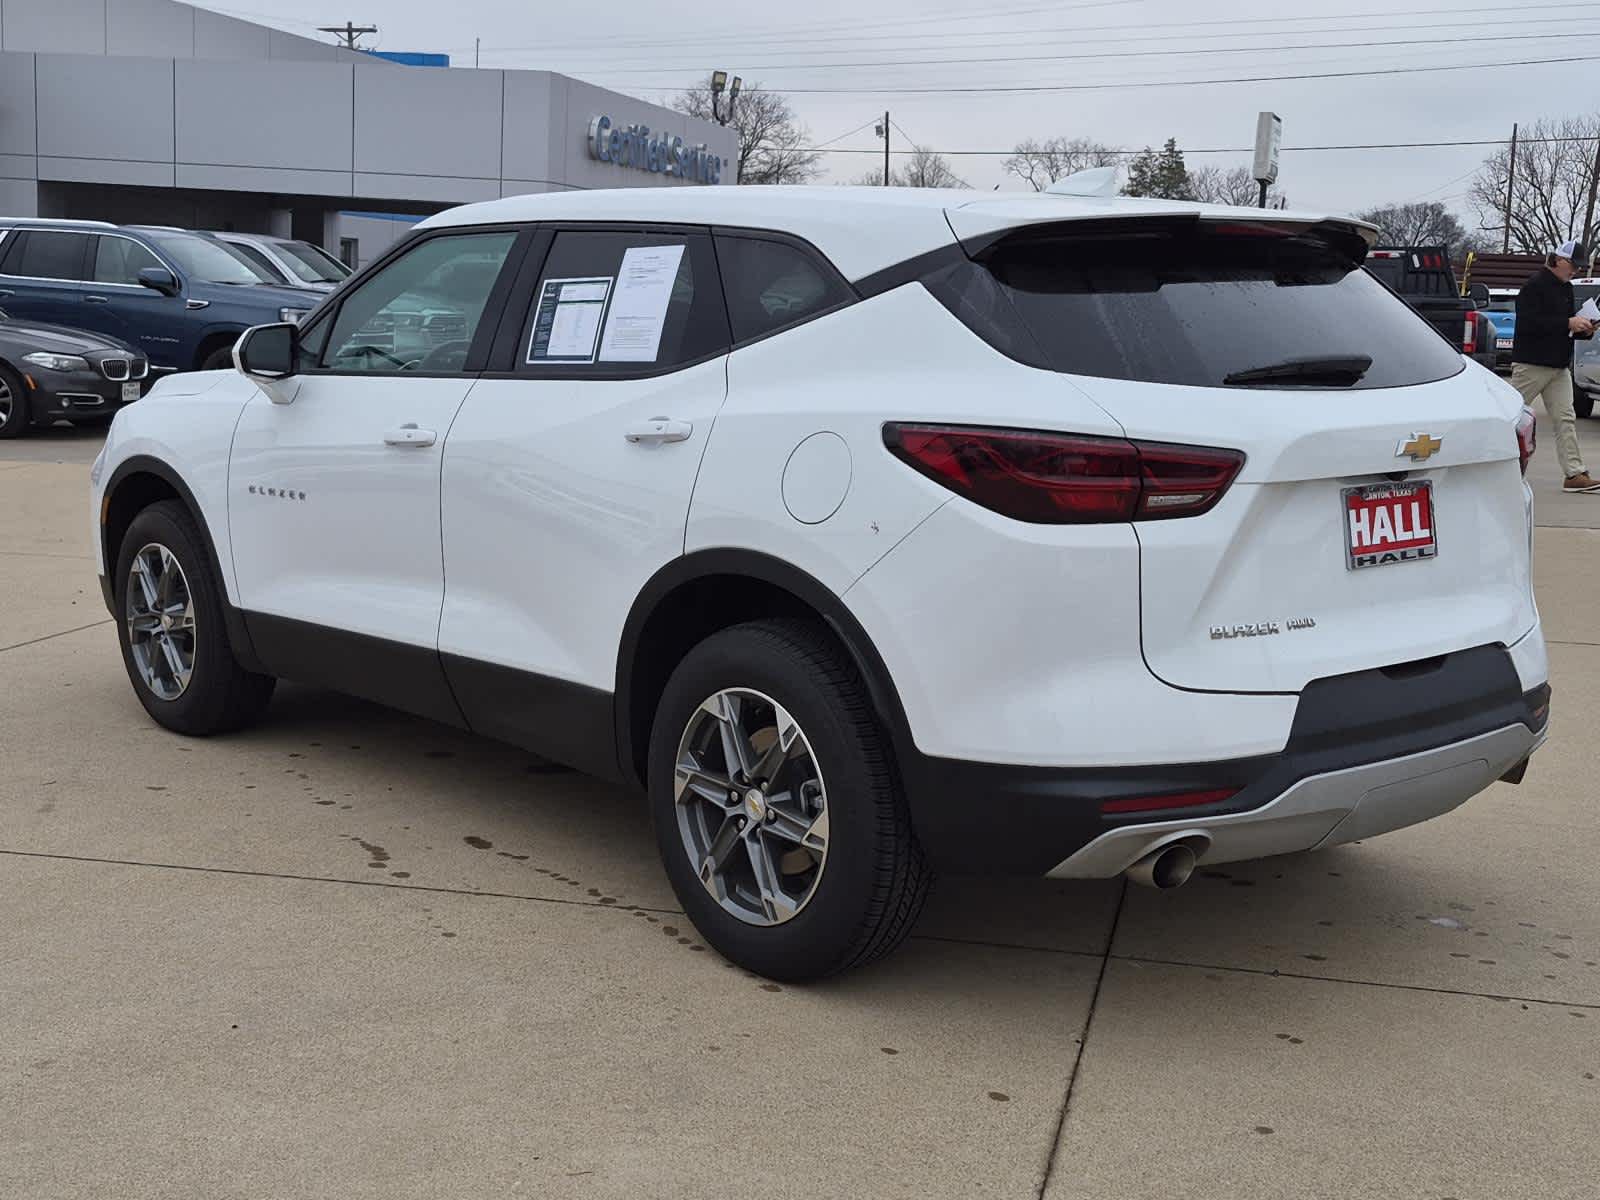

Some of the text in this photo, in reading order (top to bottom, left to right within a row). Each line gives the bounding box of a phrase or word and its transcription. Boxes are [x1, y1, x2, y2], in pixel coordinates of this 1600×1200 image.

[588, 115, 720, 185] Certified Service
[1349, 501, 1430, 548] HALL
[1357, 548, 1434, 567] HALL
[1210, 621, 1279, 640] BLAZER
